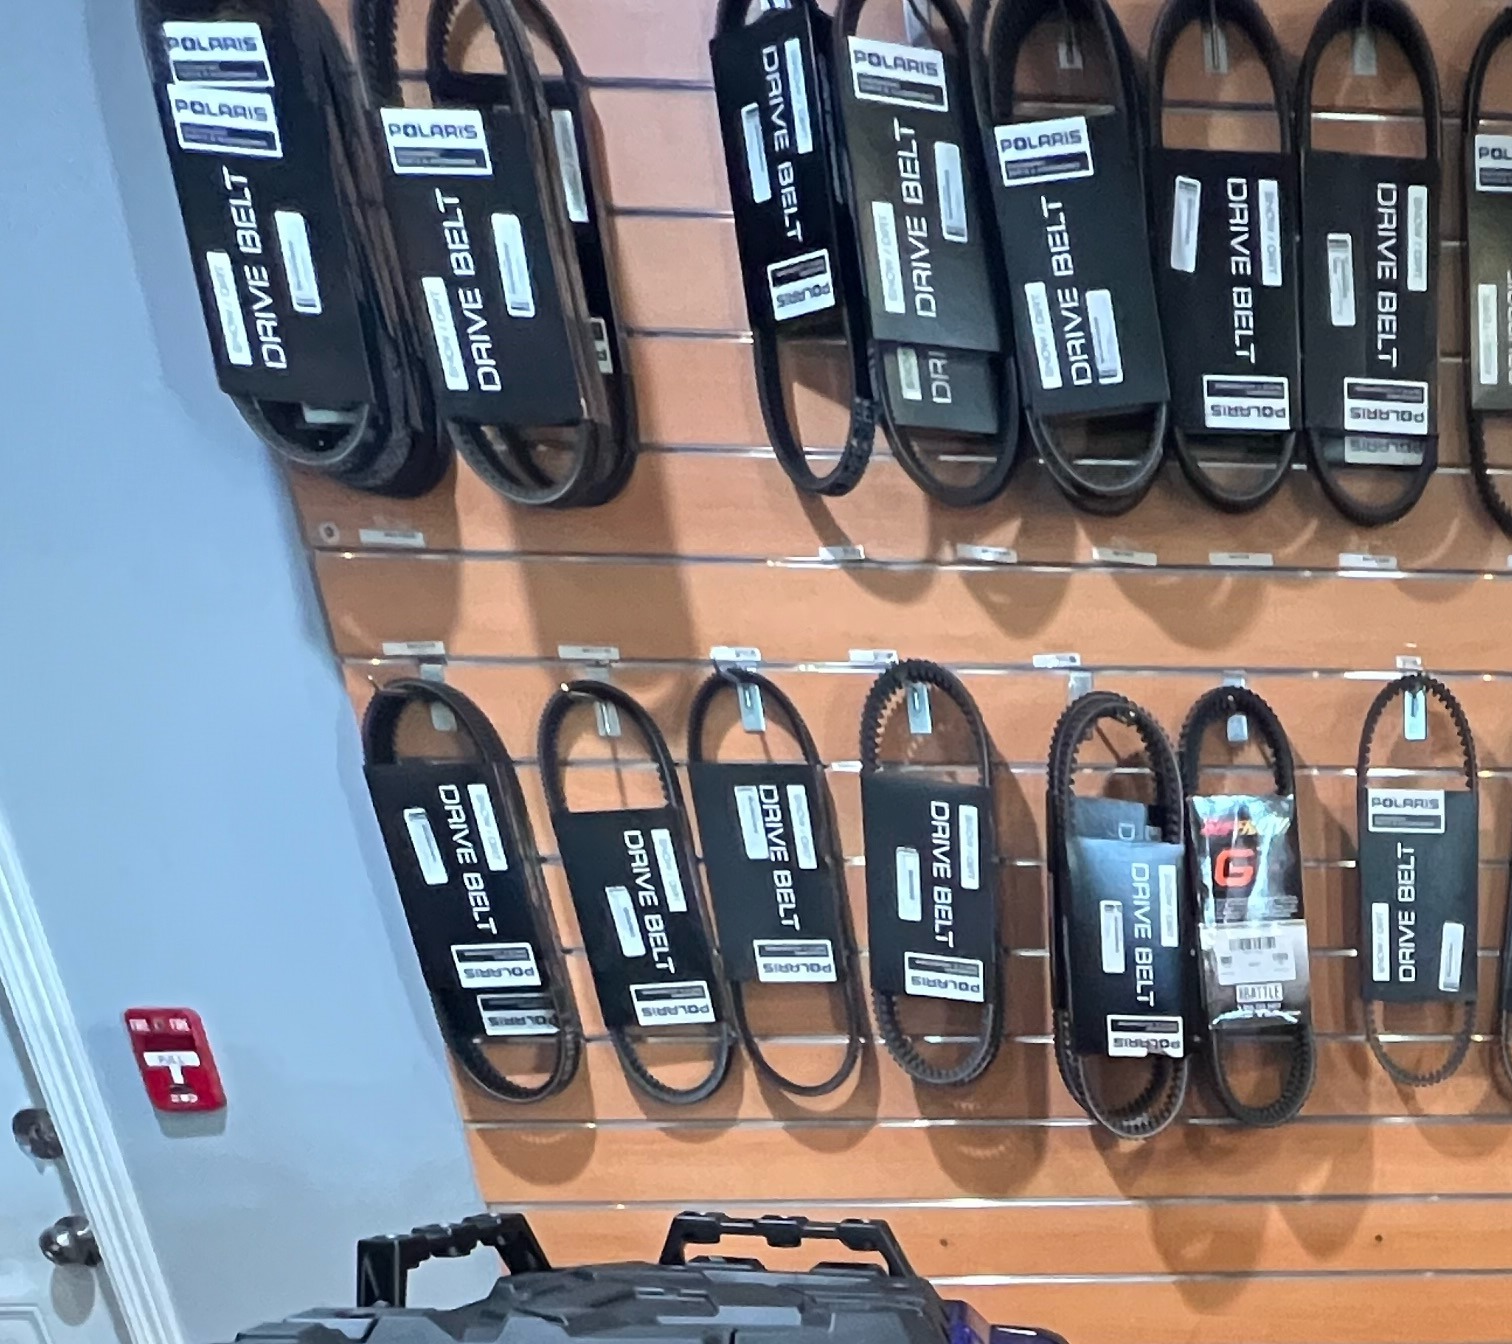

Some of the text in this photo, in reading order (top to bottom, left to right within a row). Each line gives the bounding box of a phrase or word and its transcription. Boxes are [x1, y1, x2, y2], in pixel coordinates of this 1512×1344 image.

[854, 49, 939, 78] POLARIS
[175, 98, 268, 122] POLARIS
[388, 123, 478, 140] POLARIS
[762, 45, 790, 151] DRIVE
[776, 161, 803, 242] BELT
[1001, 128, 1082, 153] POLARIS
[893, 117, 924, 205] BELT
[222, 165, 262, 254] BELT
[434, 187, 476, 276] BELT
[1041, 195, 1075, 277] BELT
[777, 281, 831, 308] POLARIS
[903, 214, 937, 318] DRIVE
[1226, 177, 1256, 364] DRIVE BELT
[1377, 183, 1398, 368] DRIVE BELT
[244, 264, 287, 370] DRIVE
[458, 287, 501, 392] DRIVE
[1054, 286, 1092, 386] DRIVE
[1211, 404, 1286, 420] POLARIS
[1350, 407, 1424, 424] POLARIS
[1371, 796, 1439, 810] POLARIS
[438, 784, 478, 865] DRIVE
[463, 872, 498, 936] BELT
[759, 784, 800, 931] DRIVE BELT
[931, 800, 954, 948] DRIVE BELT
[1214, 848, 1255, 887] G
[623, 829, 659, 907] DRIVE
[644, 914, 676, 975] BELT
[1131, 862, 1155, 1007] DRIVE BELT
[1397, 842, 1416, 982] DRIVE BELT
[463, 967, 535, 979] POLARIS
[642, 1003, 710, 1017] POLARIS
[764, 962, 832, 974] POLARIS
[911, 976, 981, 994] POLARIS
[1113, 1037, 1181, 1049] POLARIS
